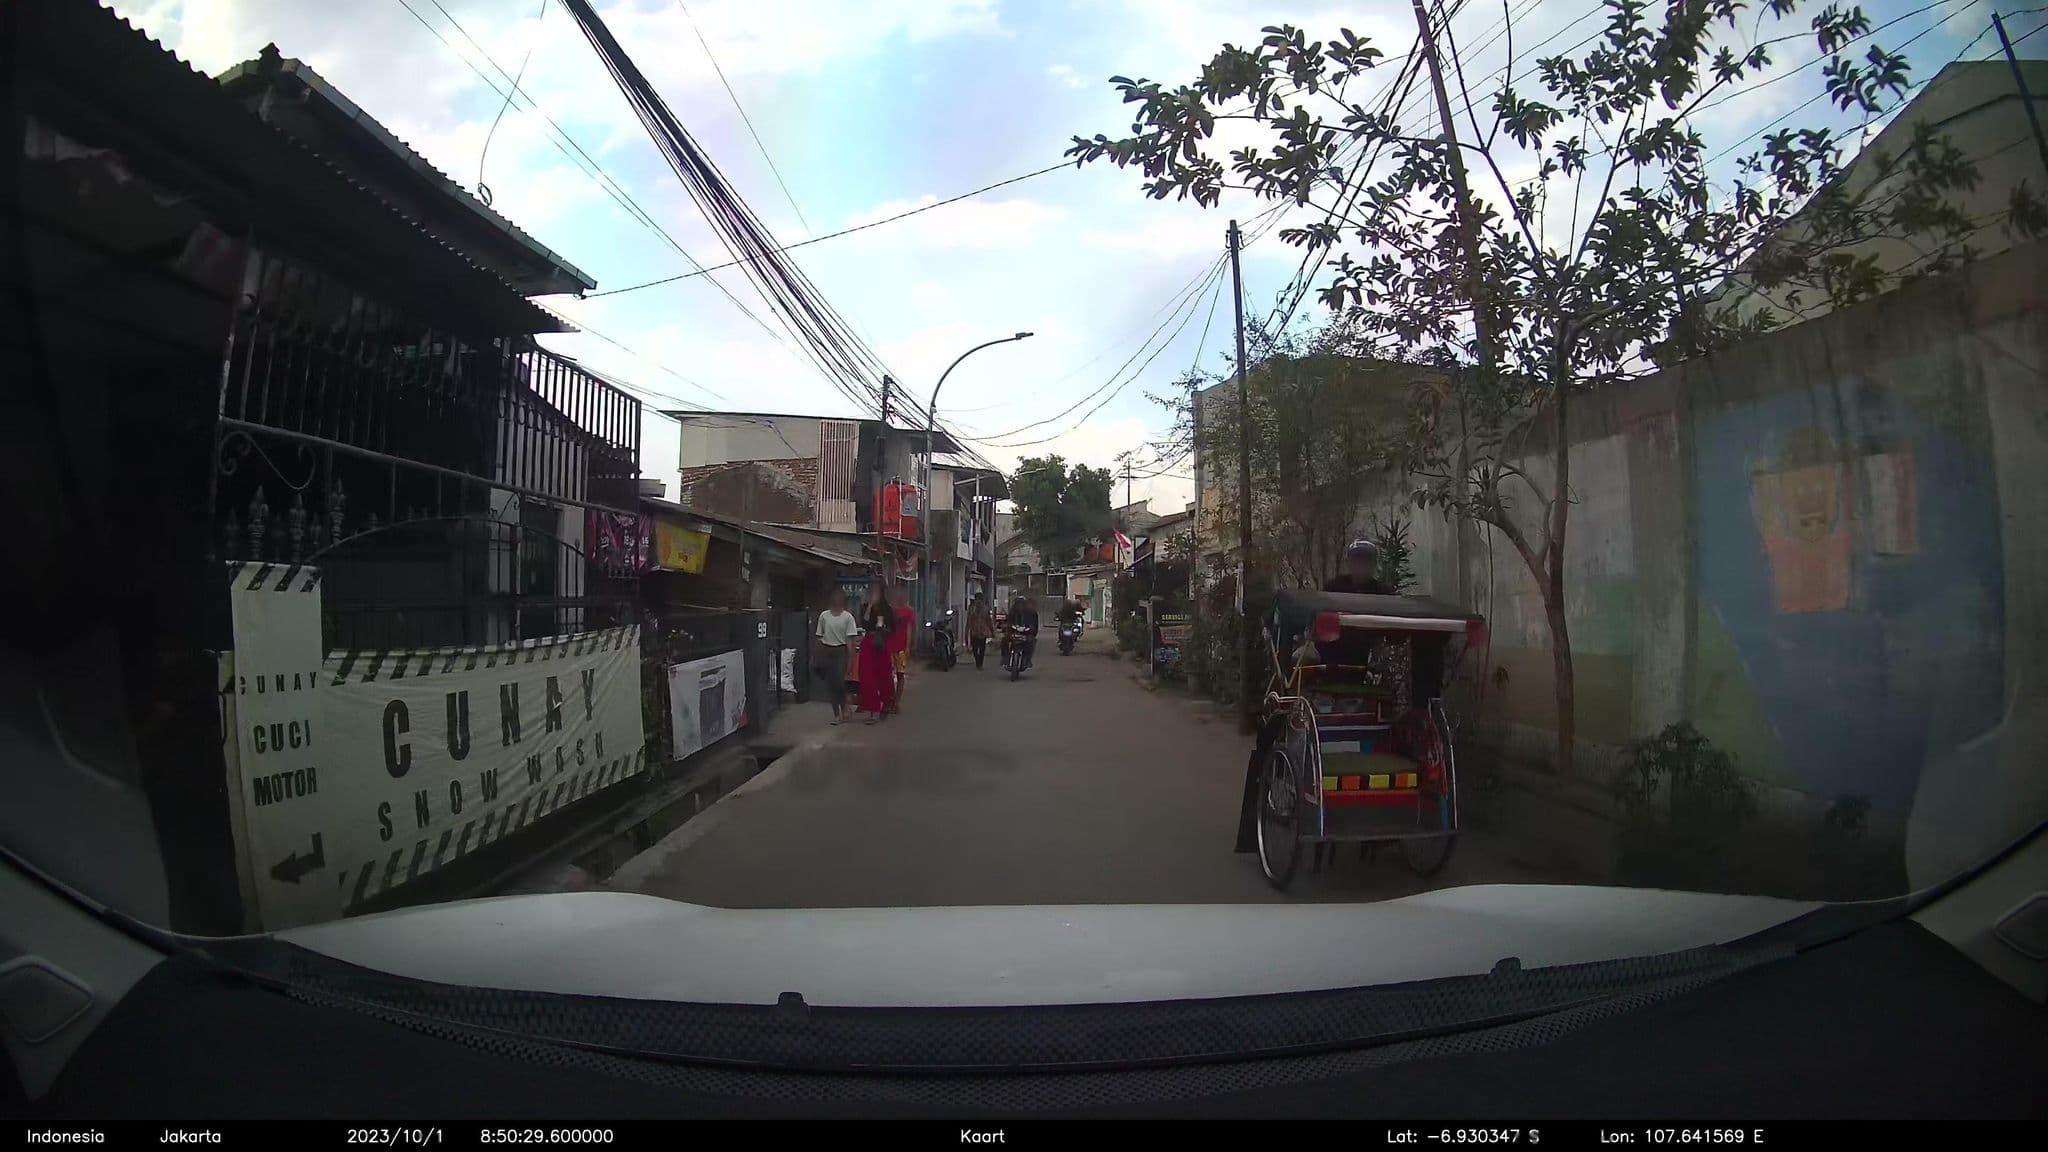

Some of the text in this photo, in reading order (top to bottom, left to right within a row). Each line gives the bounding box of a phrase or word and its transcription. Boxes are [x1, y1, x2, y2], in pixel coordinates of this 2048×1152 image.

[757, 622, 768, 638] 98
[252, 720, 311, 754] CUCI
[383, 669, 595, 778] CUNAY
[253, 767, 318, 806] MOTOR
[378, 731, 604, 841] SNOW WASH
